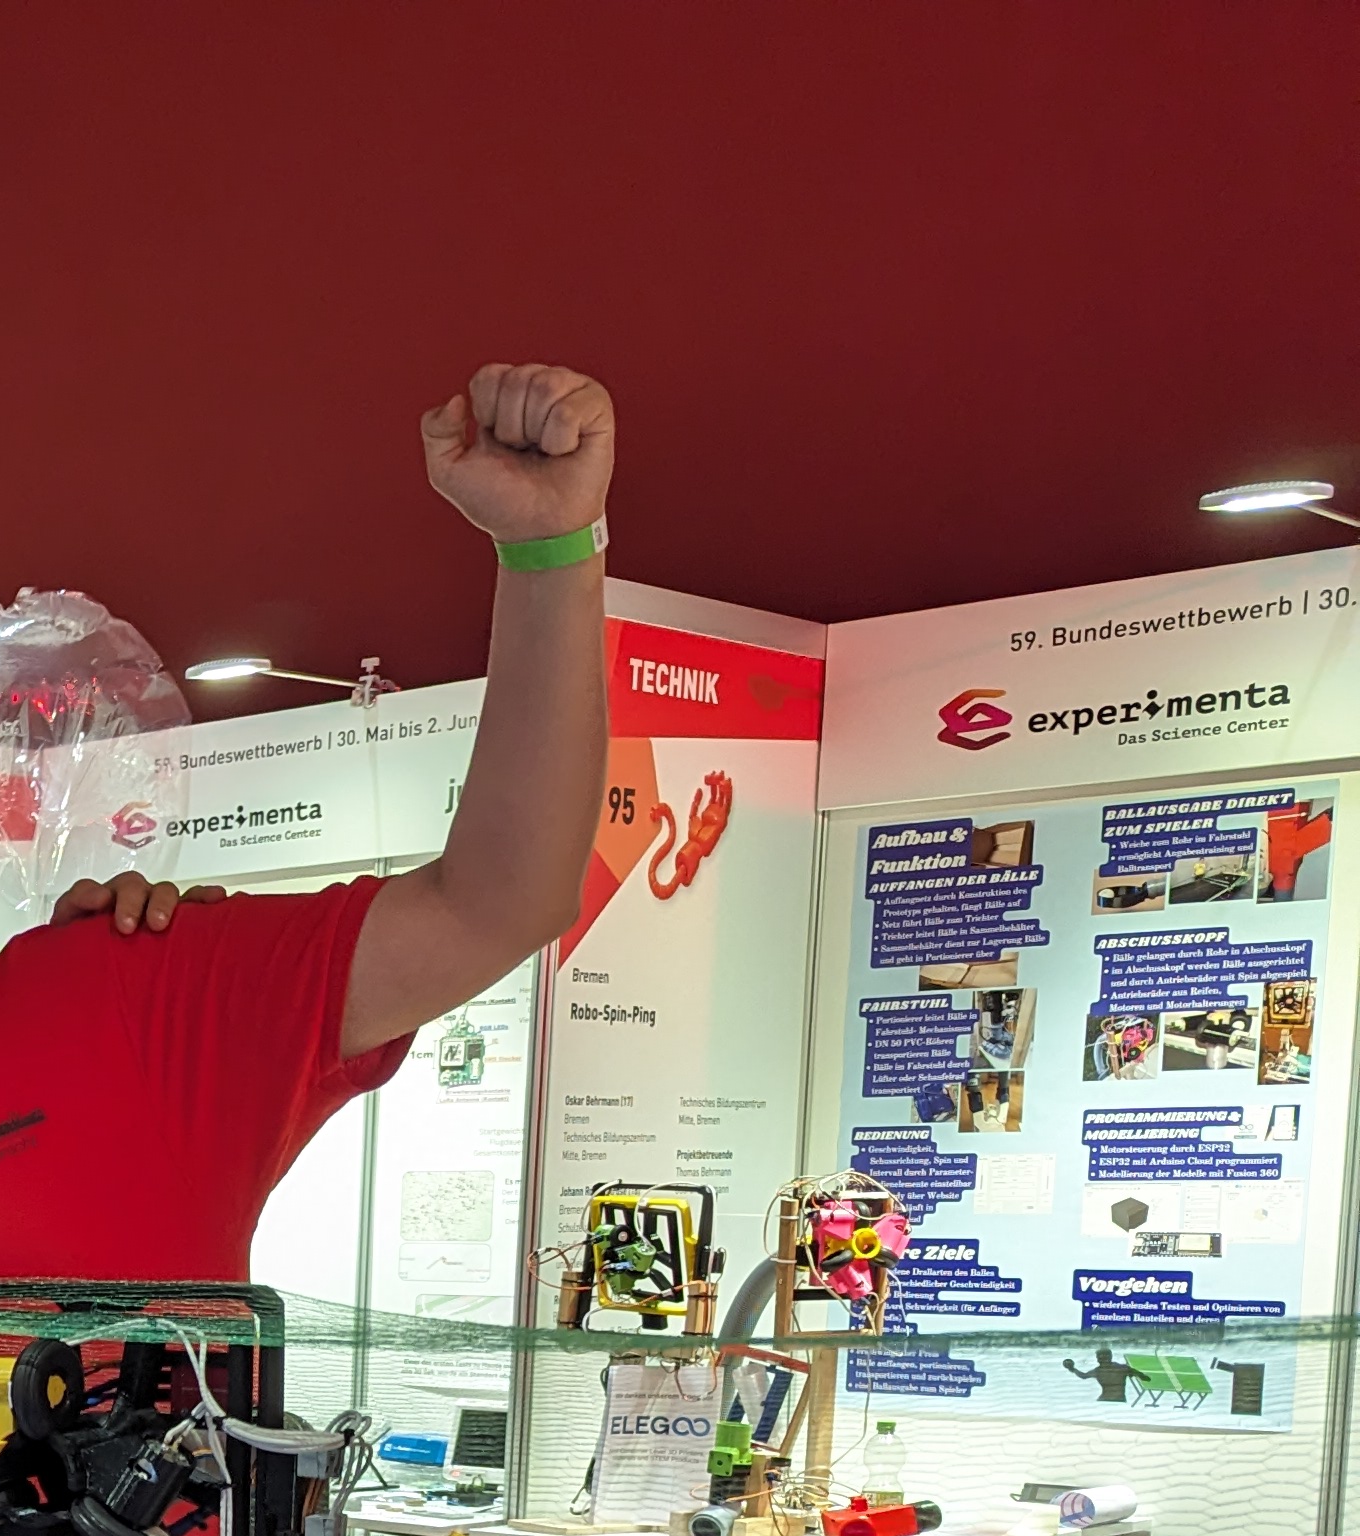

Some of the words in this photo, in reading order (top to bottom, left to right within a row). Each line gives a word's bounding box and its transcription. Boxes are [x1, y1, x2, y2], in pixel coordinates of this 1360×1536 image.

[1010, 630, 1044, 652] 59.
[1052, 597, 1292, 648] Bundeswettbewerb
[1319, 586, 1357, 610] 30.
[630, 657, 720, 704] TECHNIK
[1118, 731, 1147, 747] Das
[1152, 722, 1222, 744] Science
[1227, 715, 1290, 735] Center
[179, 735, 321, 770] Bundeswettbewerb
[337, 729, 360, 747] 30.
[366, 723, 393, 743] Mai
[399, 720, 422, 738] bis
[427, 717, 442, 735] 2.
[447, 714, 477, 732] Jun
[609, 786, 636, 825] 95
[1105, 801, 1223, 820] BALLAUSGABE
[1225, 792, 1293, 809] DIREKT
[1104, 826, 1142, 837] ZUM
[1144, 819, 1213, 834] SPIELER
[219, 837, 237, 849] Das
[240, 831, 281, 847] Science
[285, 828, 321, 842] Center
[872, 830, 947, 849] Aufbau
[949, 827, 968, 841] &
[870, 854, 966, 875] Funktion
[869, 878, 954, 893] AUFFANGEN
[957, 874, 987, 887] DER
[989, 869, 1039, 884] BÄLLE
[1096, 932, 1227, 949] ABSCHUSSKOPF
[572, 968, 609, 983] Bremen
[861, 998, 949, 1013] FAHRSTUHL
[570, 1003, 656, 1027] Robo-Spin-Ping
[410, 1051, 433, 1059] 1cm
[565, 1096, 584, 1106] Oskar
[586, 1096, 619, 1106] Behrmann
[680, 1097, 715, 1107] Technisches
[717, 1098, 766, 1110] Bildungszentrum
[564, 1114, 589, 1124] Bremen
[1085, 1111, 1226, 1124] PROGRAMMIERUNG
[564, 1132, 601, 1142] Technisches
[603, 1132, 656, 1145] Bildungszentrum
[854, 1131, 929, 1141] BEDIENUNG
[1084, 1128, 1199, 1140] MODELLIERUNG
[677, 1150, 732, 1161] Projektbetreuende
[676, 1167, 699, 1177] Thomas
[701, 1168, 731, 1177] Behrmann
[923, 1245, 975, 1261] Ziele
[1079, 1276, 1188, 1296] Vorgehen
[611, 1416, 711, 1437] ELEGOO
